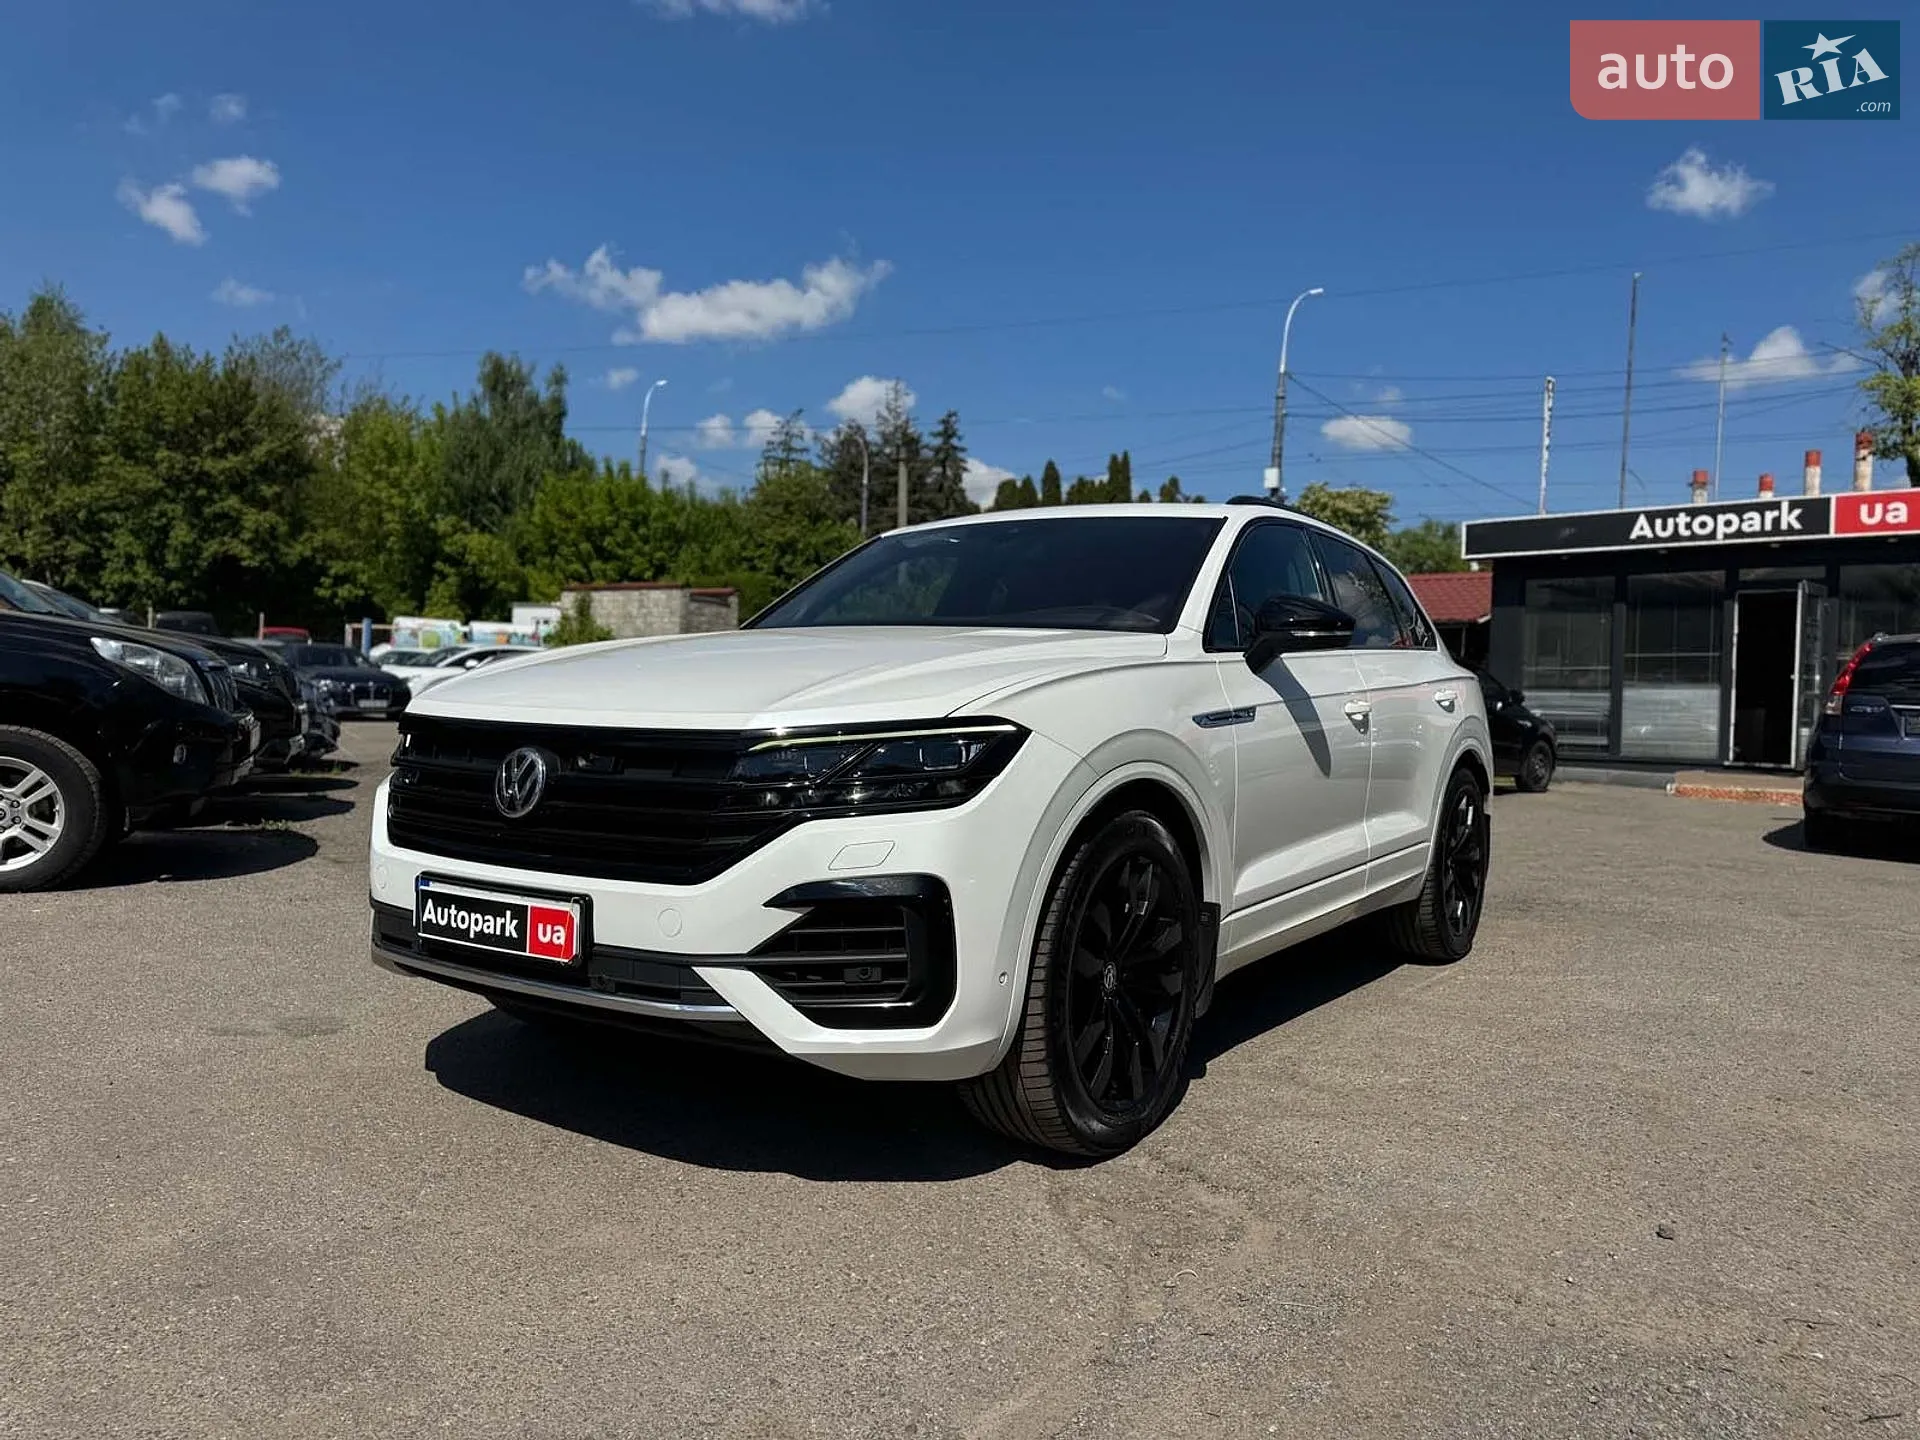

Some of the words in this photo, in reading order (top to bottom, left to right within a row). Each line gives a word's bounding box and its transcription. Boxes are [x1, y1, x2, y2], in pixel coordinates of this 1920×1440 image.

[1629, 500, 1803, 541] Autopark
[1859, 501, 1908, 526] ua
[423, 898, 519, 938] Autopark
[537, 922, 566, 945] ua
